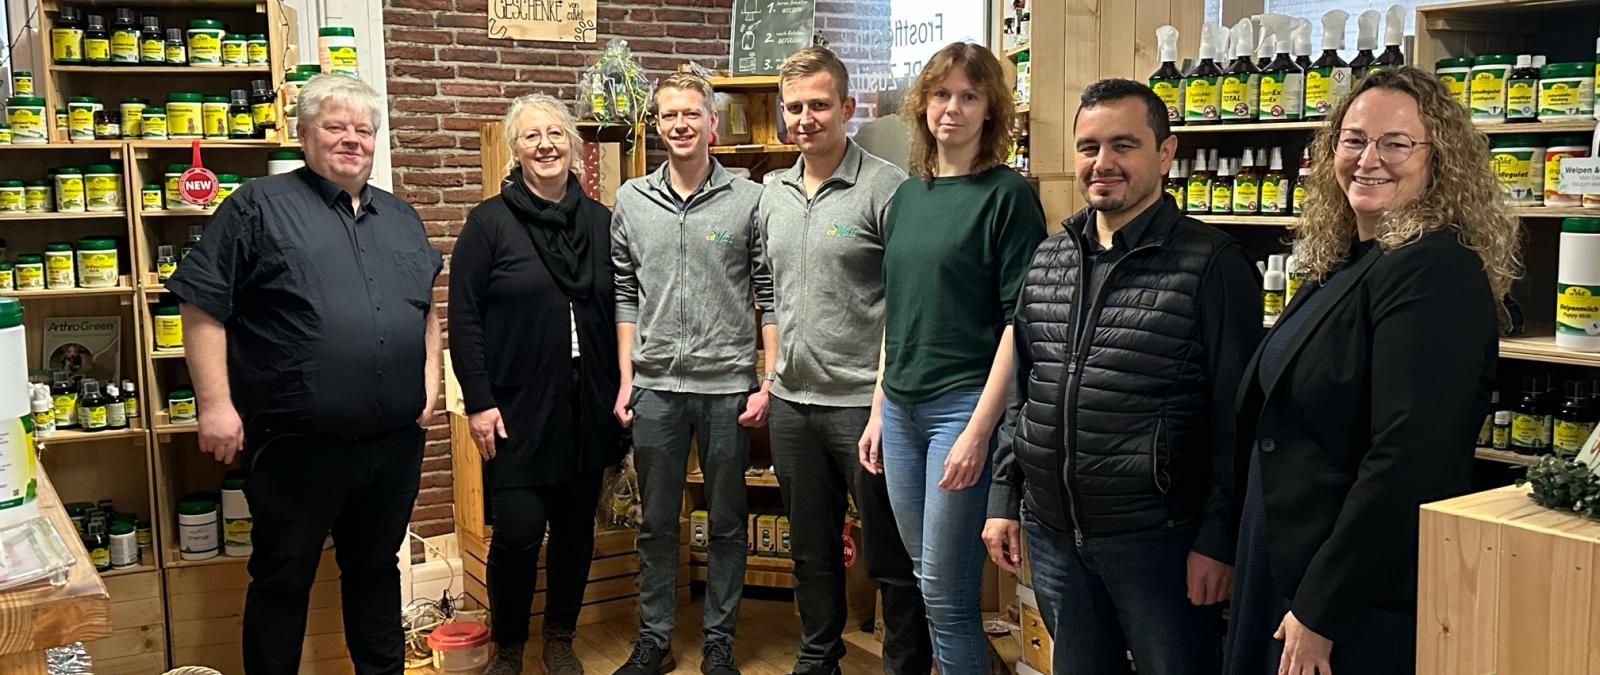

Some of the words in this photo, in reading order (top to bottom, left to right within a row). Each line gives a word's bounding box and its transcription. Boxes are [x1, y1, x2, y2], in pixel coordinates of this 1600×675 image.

[494, 0, 563, 22] GESCHENKE
[767, 2, 776, 14] 1.
[763, 58, 773, 70] 3.
[1191, 97, 1207, 105] Spray
[1565, 166, 1593, 175] Welpen
[185, 180, 213, 191] NEW
[1559, 303, 1599, 313] Welpenmilch
[843, 546, 854, 557] EW
